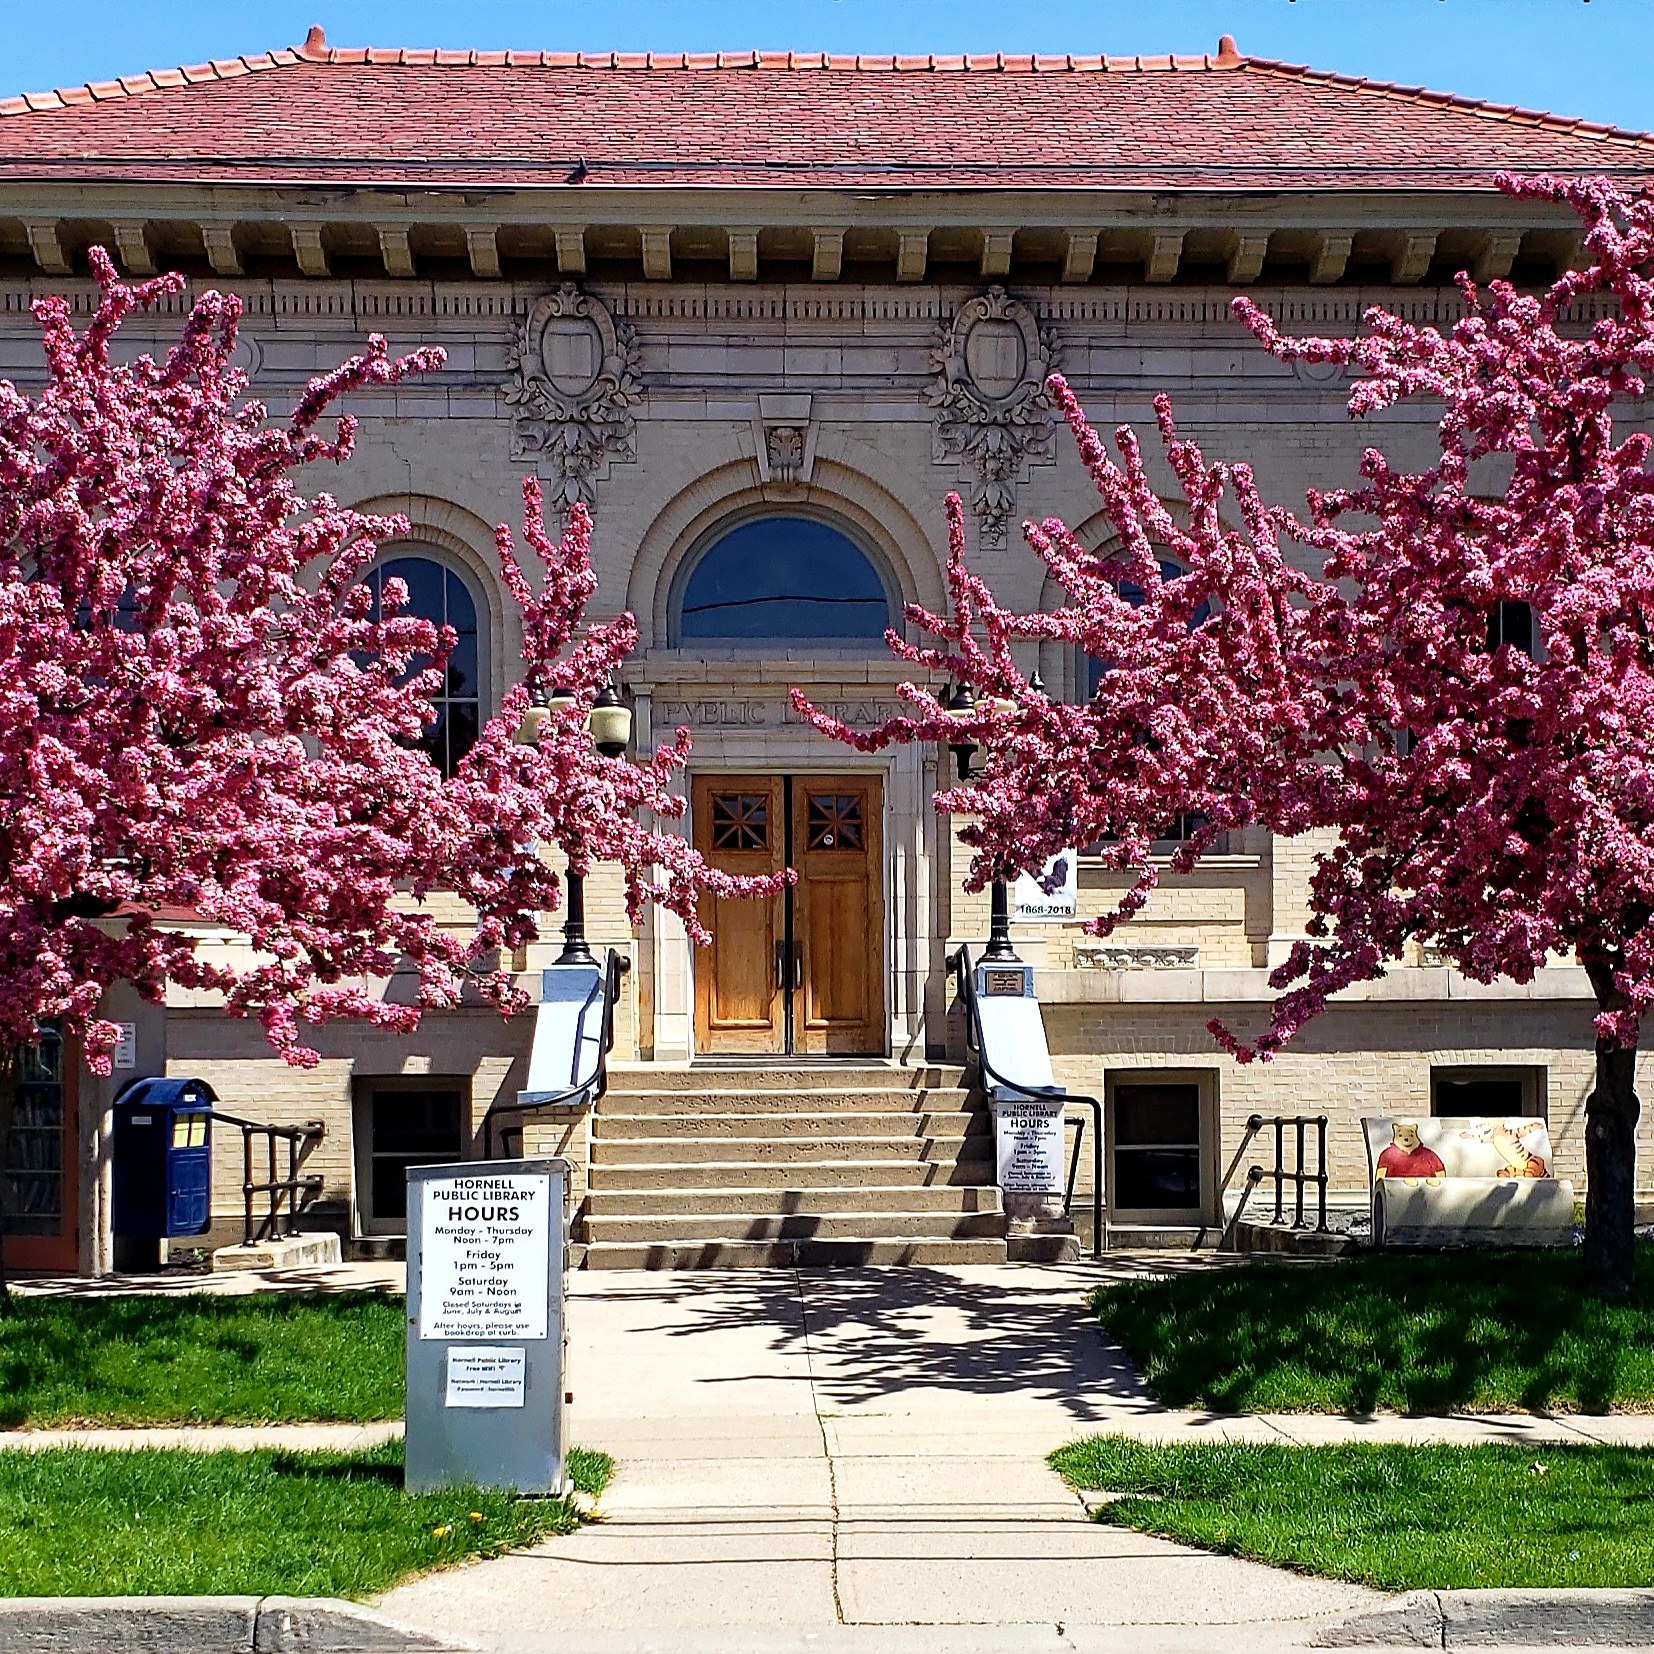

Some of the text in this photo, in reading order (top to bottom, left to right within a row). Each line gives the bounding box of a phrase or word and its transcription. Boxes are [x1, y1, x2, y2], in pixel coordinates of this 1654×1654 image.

[663, 702, 765, 724] PVBLIC
[1020, 905, 1071, 914] 1868-2018
[1010, 1119, 1049, 1128] HOURS
[454, 1179, 515, 1189] HORNELL
[433, 1190, 536, 1201] PUBLIC LIBRARY
[448, 1206, 520, 1221] HOURS
[434, 1226, 476, 1236] Monday
[486, 1226, 533, 1236] Thursday
[453, 1236, 481, 1244] Noon
[492, 1236, 514, 1245] 7pm
[466, 1250, 501, 1261] Friday
[453, 1261, 478, 1271] 1pm
[489, 1261, 514, 1271] 5pm
[458, 1276, 508, 1287] Saturday
[449, 1287, 474, 1296] 9am
[487, 1287, 517, 1296] Noon
[485, 1322, 513, 1330] please
